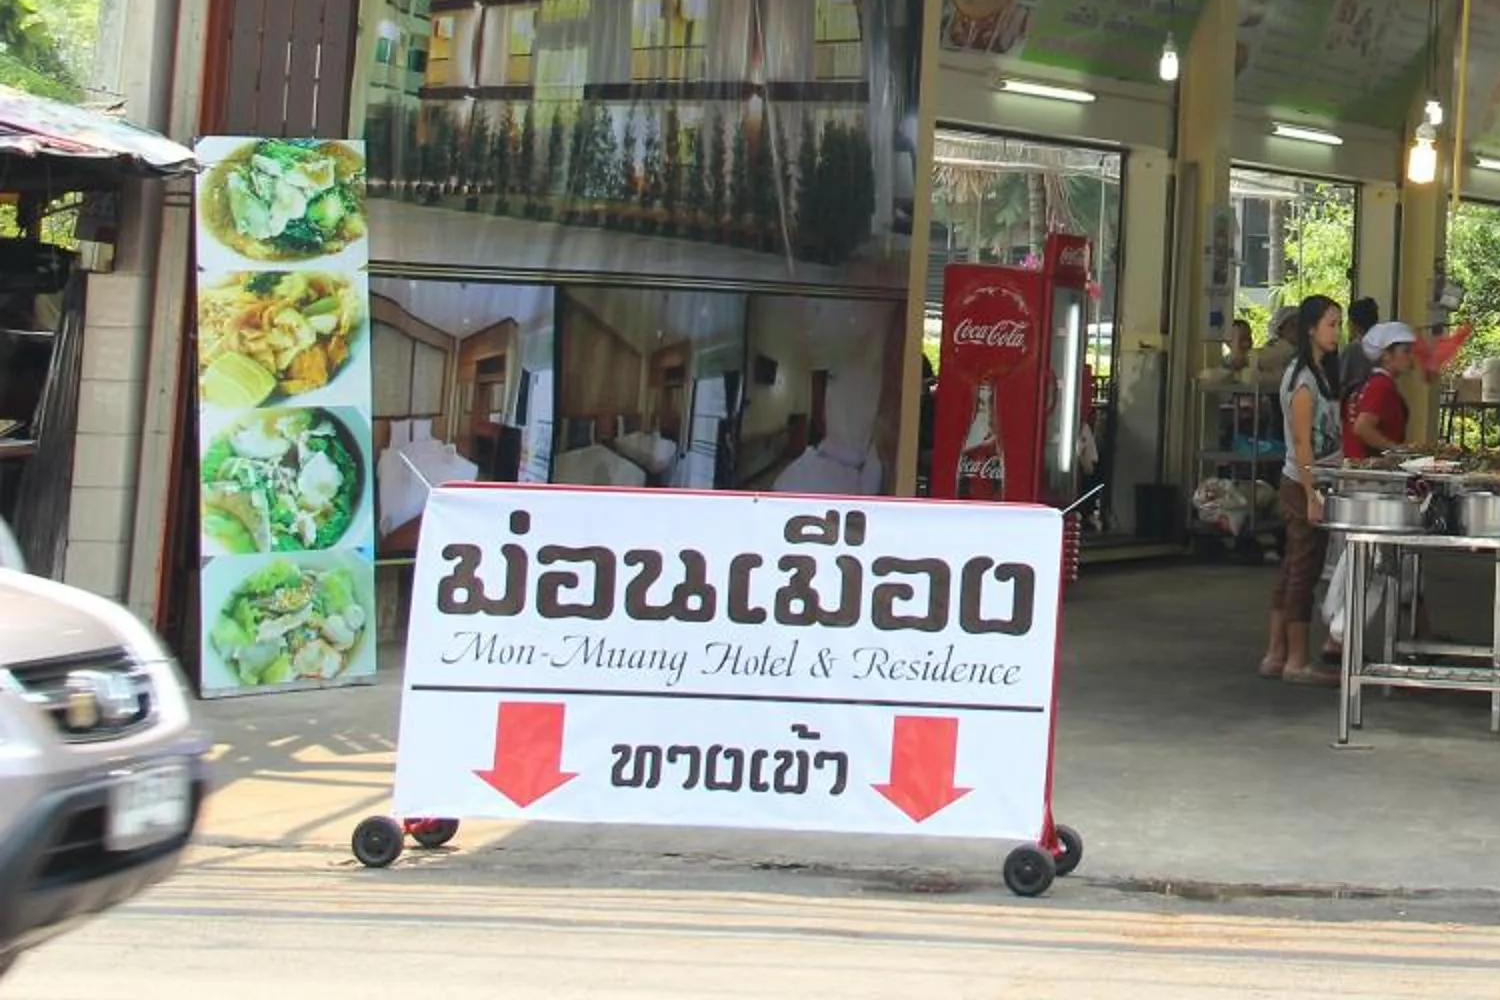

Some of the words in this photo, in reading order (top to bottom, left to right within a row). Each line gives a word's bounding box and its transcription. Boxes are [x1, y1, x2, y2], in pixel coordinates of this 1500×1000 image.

[437, 509, 1037, 637] ม่อนเมือง
[700, 639, 802, 680] Hotel
[809, 651, 836, 680] &
[850, 646, 1023, 688] Residence
[611, 723, 849, 796] ทางเข้า
